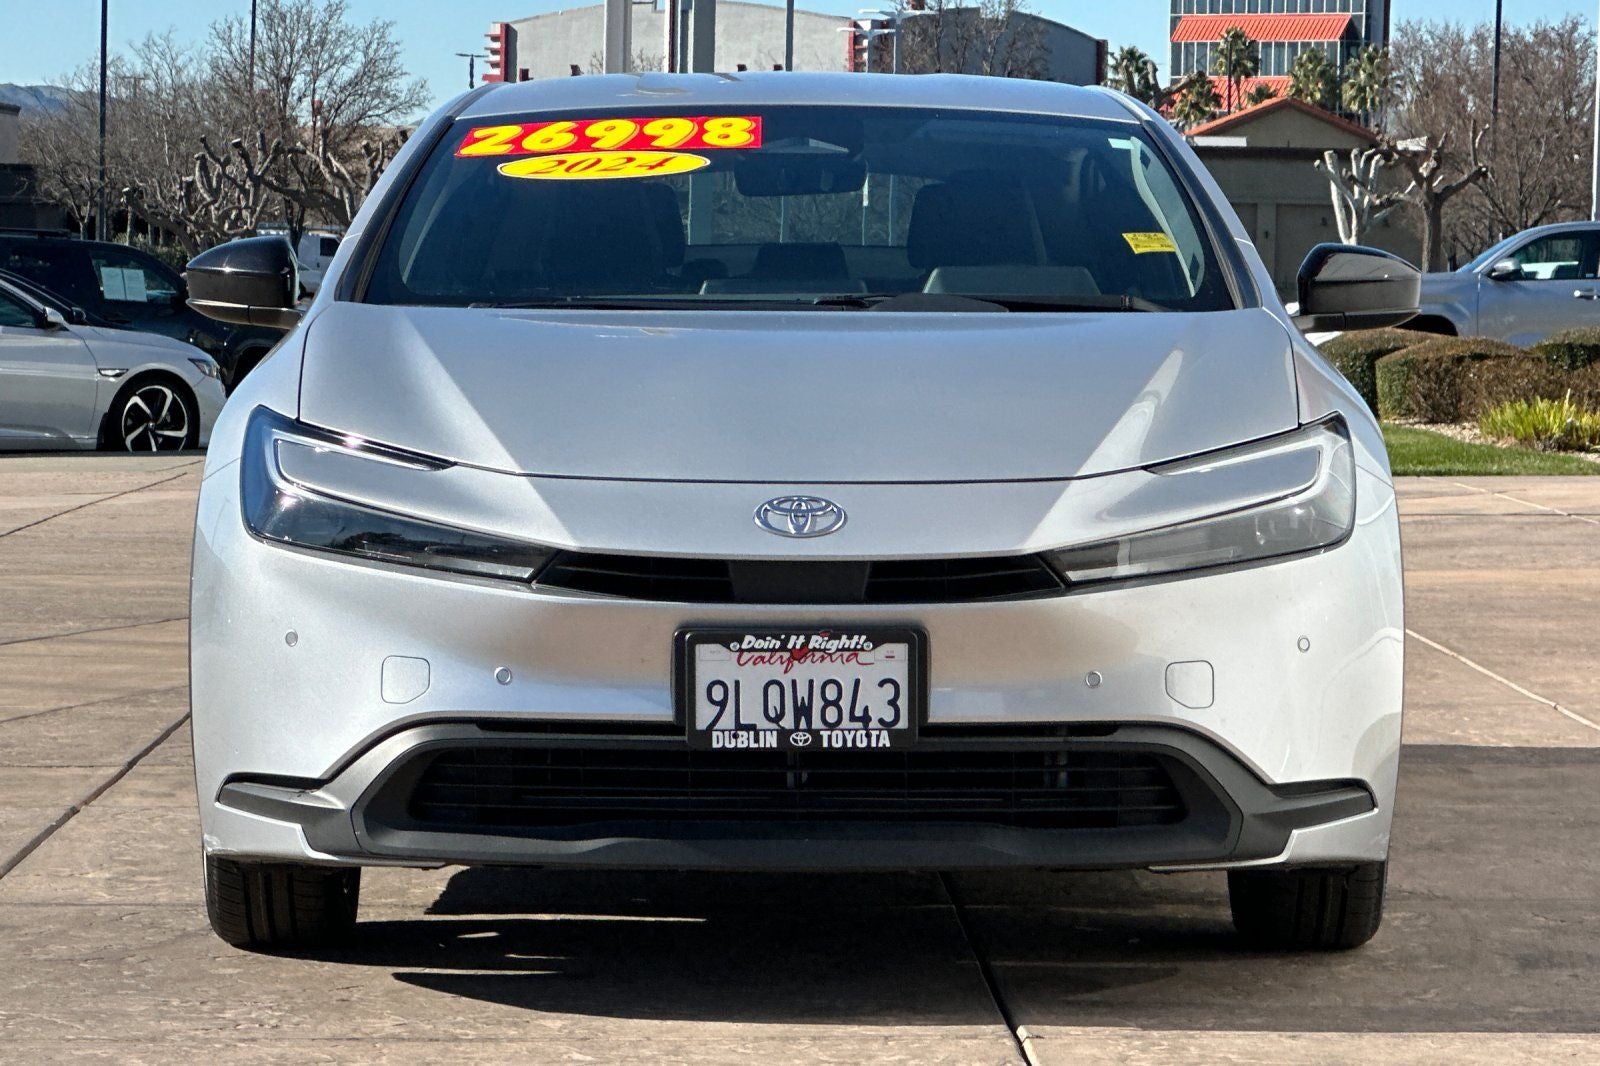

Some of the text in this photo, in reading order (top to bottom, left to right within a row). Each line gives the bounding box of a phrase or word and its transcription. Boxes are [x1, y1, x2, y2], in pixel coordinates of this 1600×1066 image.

[460, 117, 755, 155] 26998
[526, 156, 677, 175] 2024
[741, 634, 867, 654] Doin' It Right!
[705, 678, 901, 730] 9LQW843
[711, 730, 891, 748] DUBLIN TOYOTA
